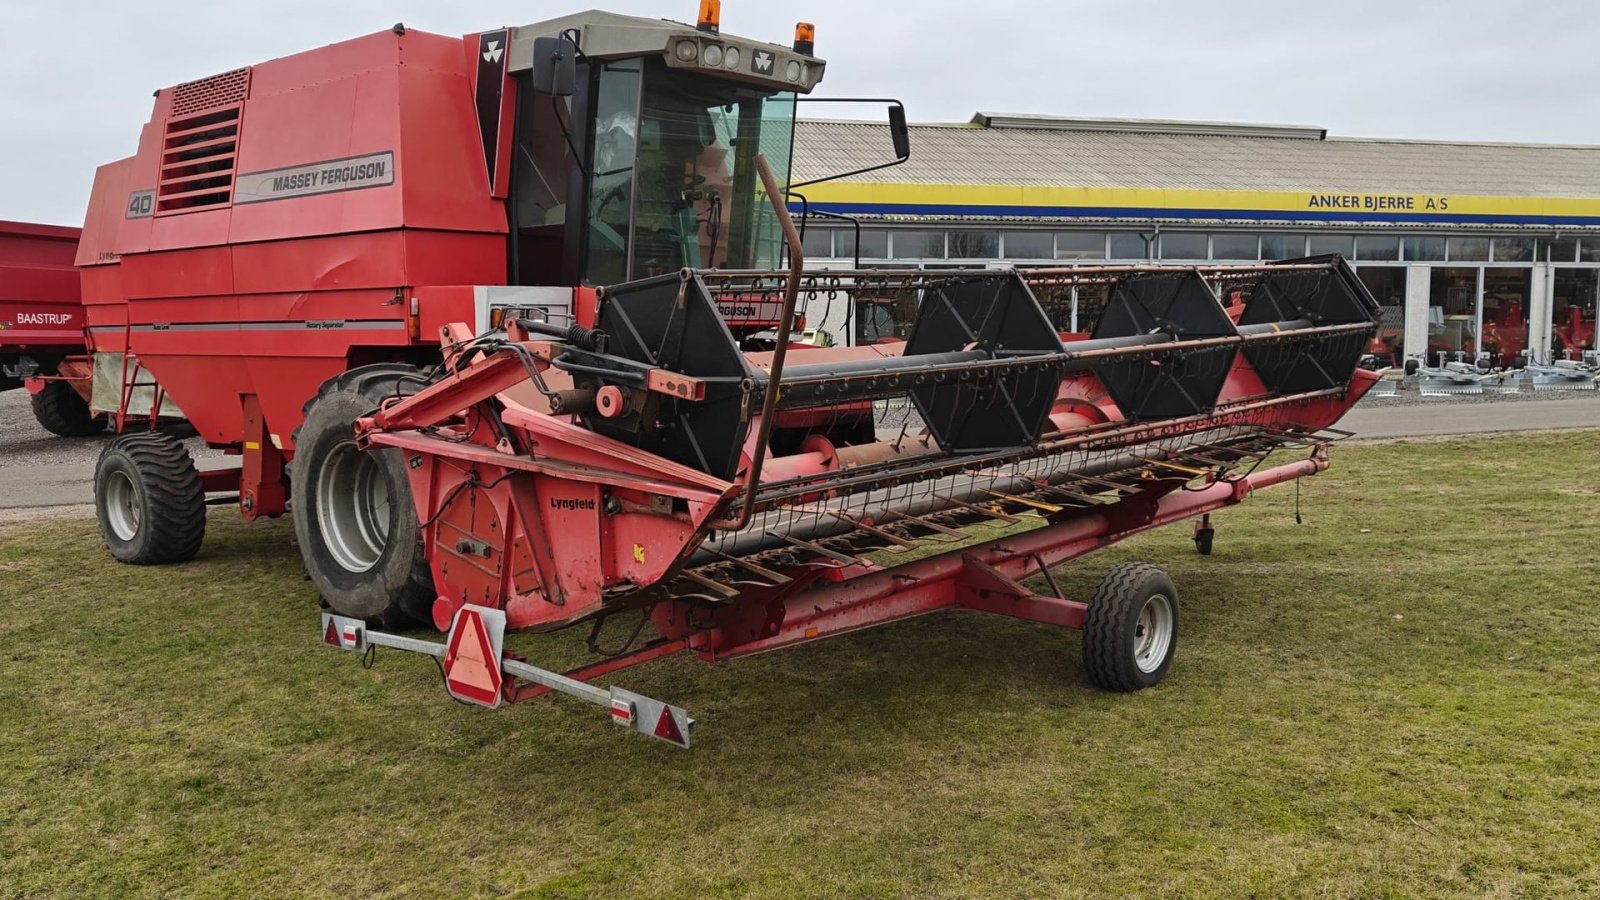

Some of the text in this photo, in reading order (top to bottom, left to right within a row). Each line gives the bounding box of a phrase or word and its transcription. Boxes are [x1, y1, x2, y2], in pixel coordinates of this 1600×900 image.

[272, 161, 385, 192] MASSEY FERGUSON
[129, 194, 152, 215] 40
[1308, 194, 1448, 211] ANKER BJERRE A/S
[716, 306, 756, 316] RGUSON
[551, 498, 595, 510] Lyngfeld
